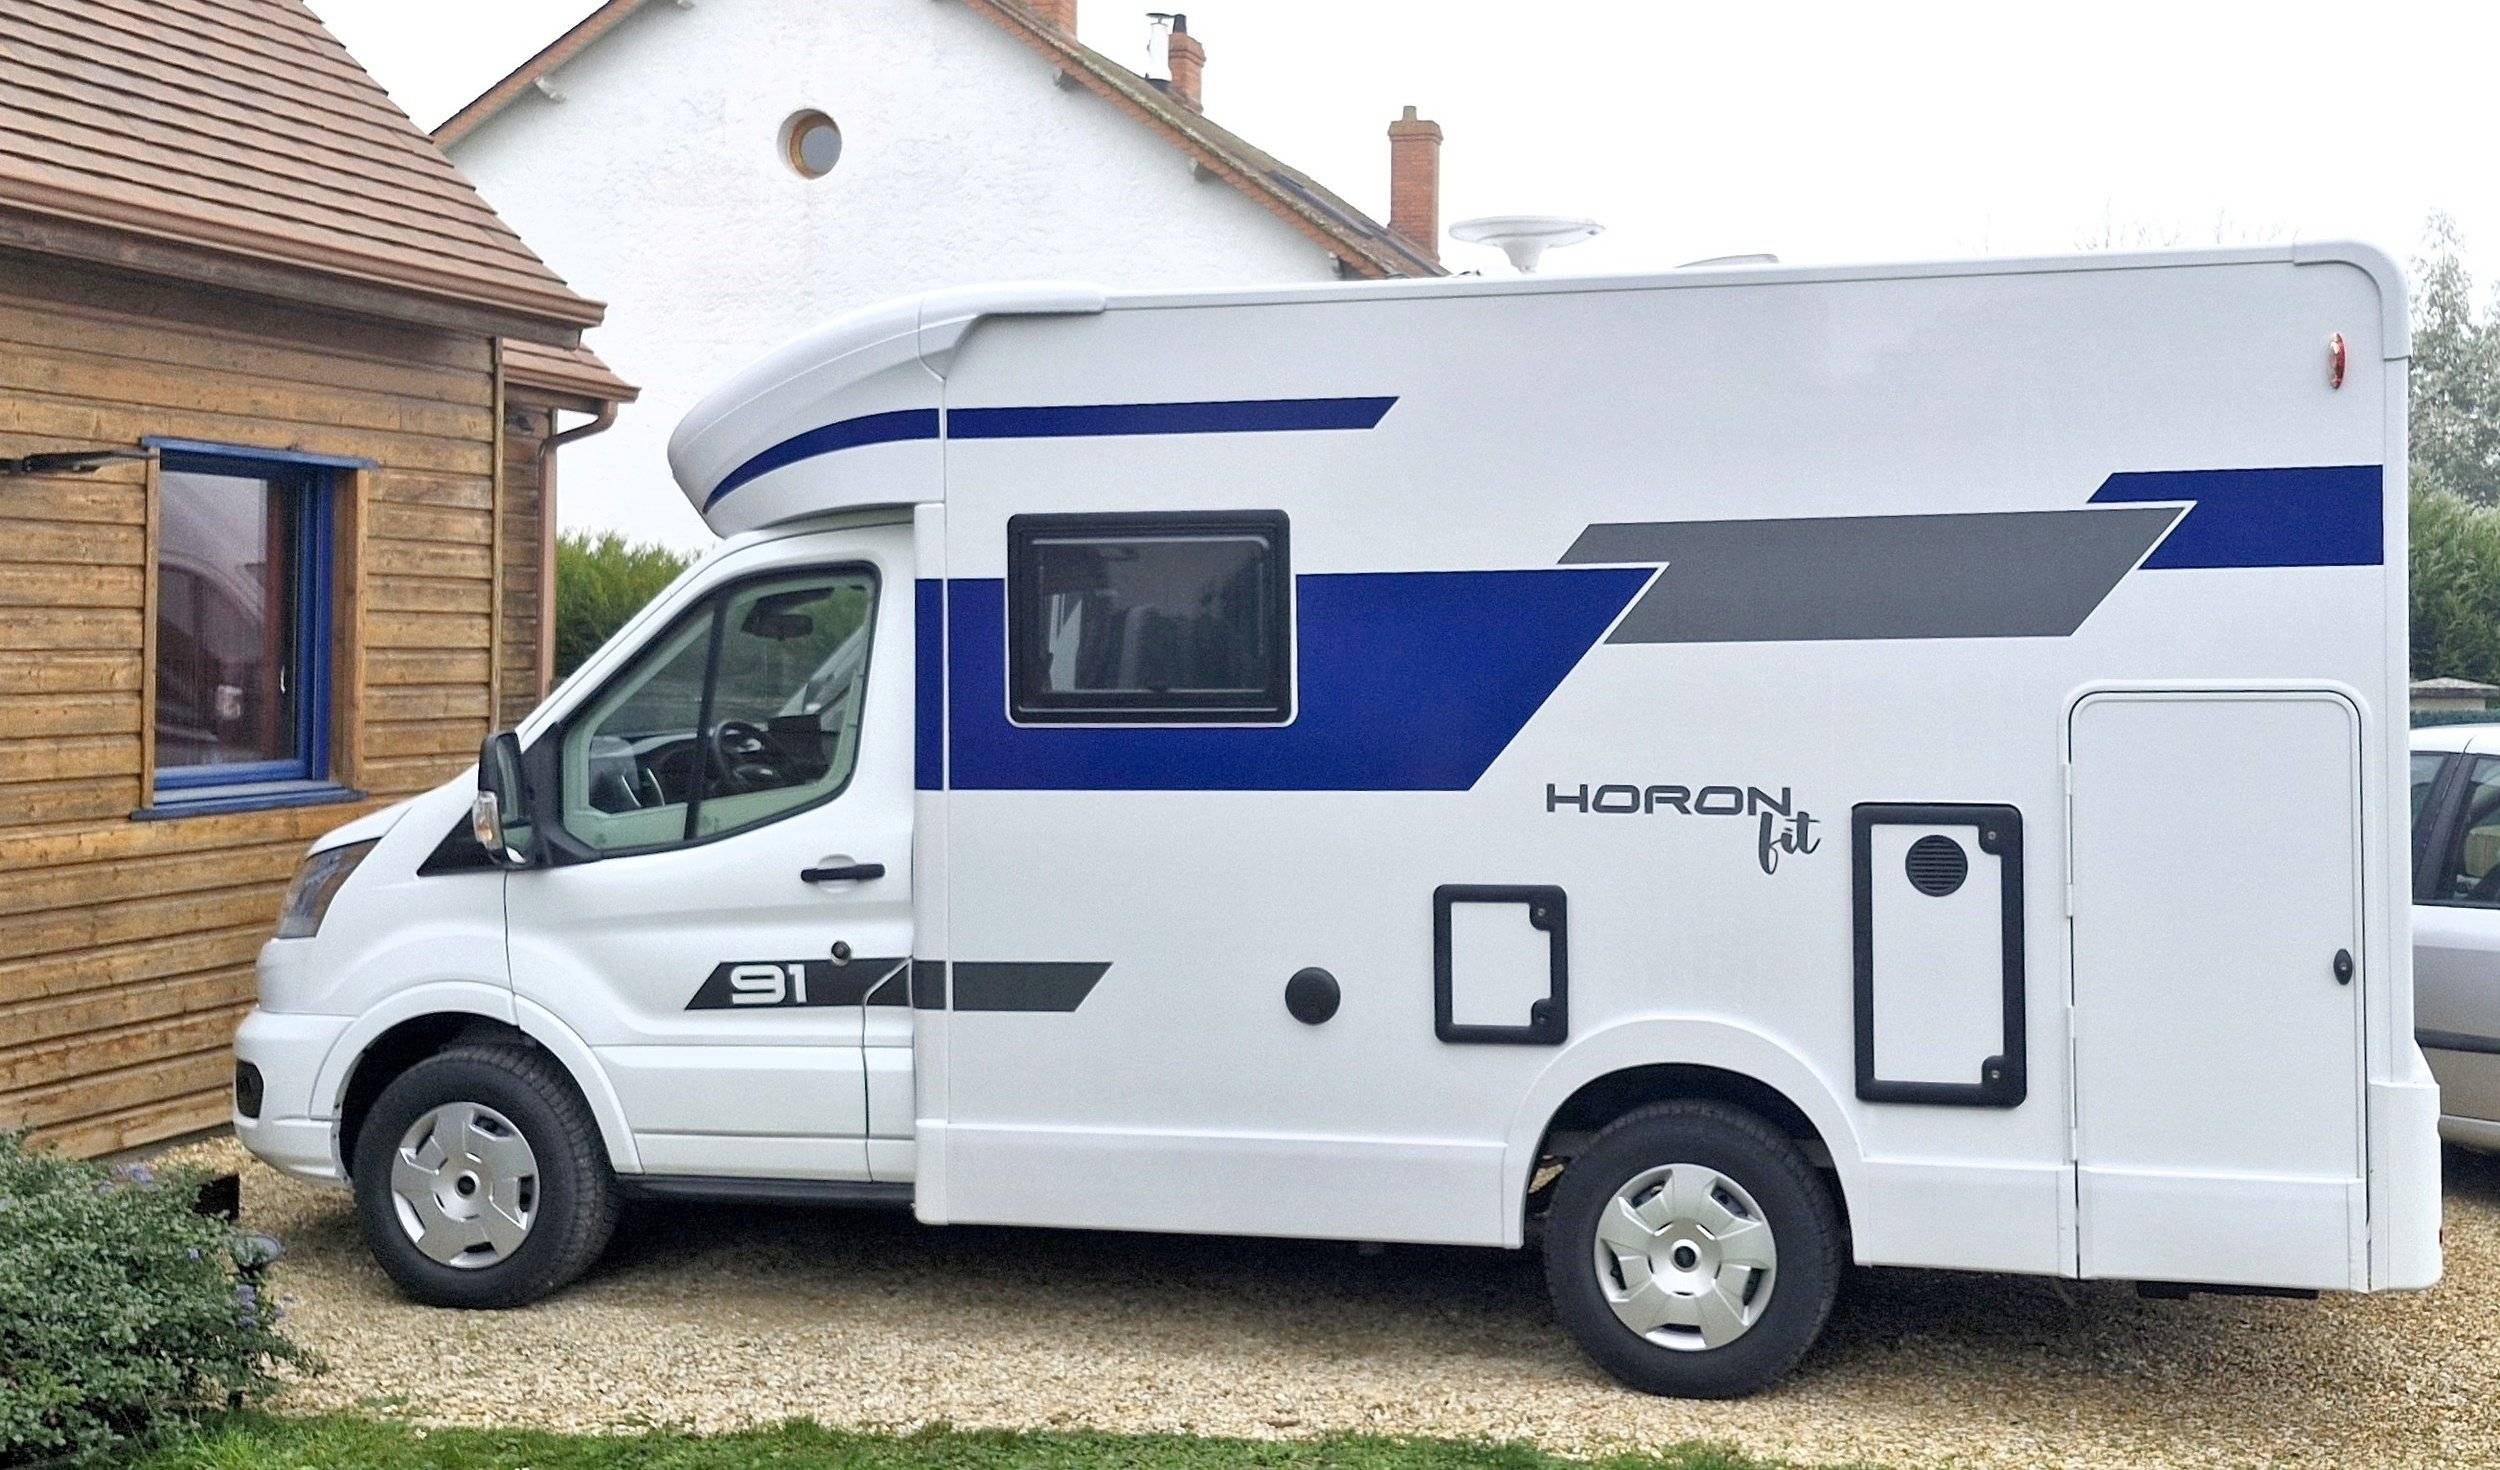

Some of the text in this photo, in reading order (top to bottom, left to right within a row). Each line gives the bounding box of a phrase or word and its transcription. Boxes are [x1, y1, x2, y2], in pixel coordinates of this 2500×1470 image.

[1546, 783, 1791, 817] HORON
[1758, 811, 1821, 875] fit
[730, 963, 807, 1005] 91
